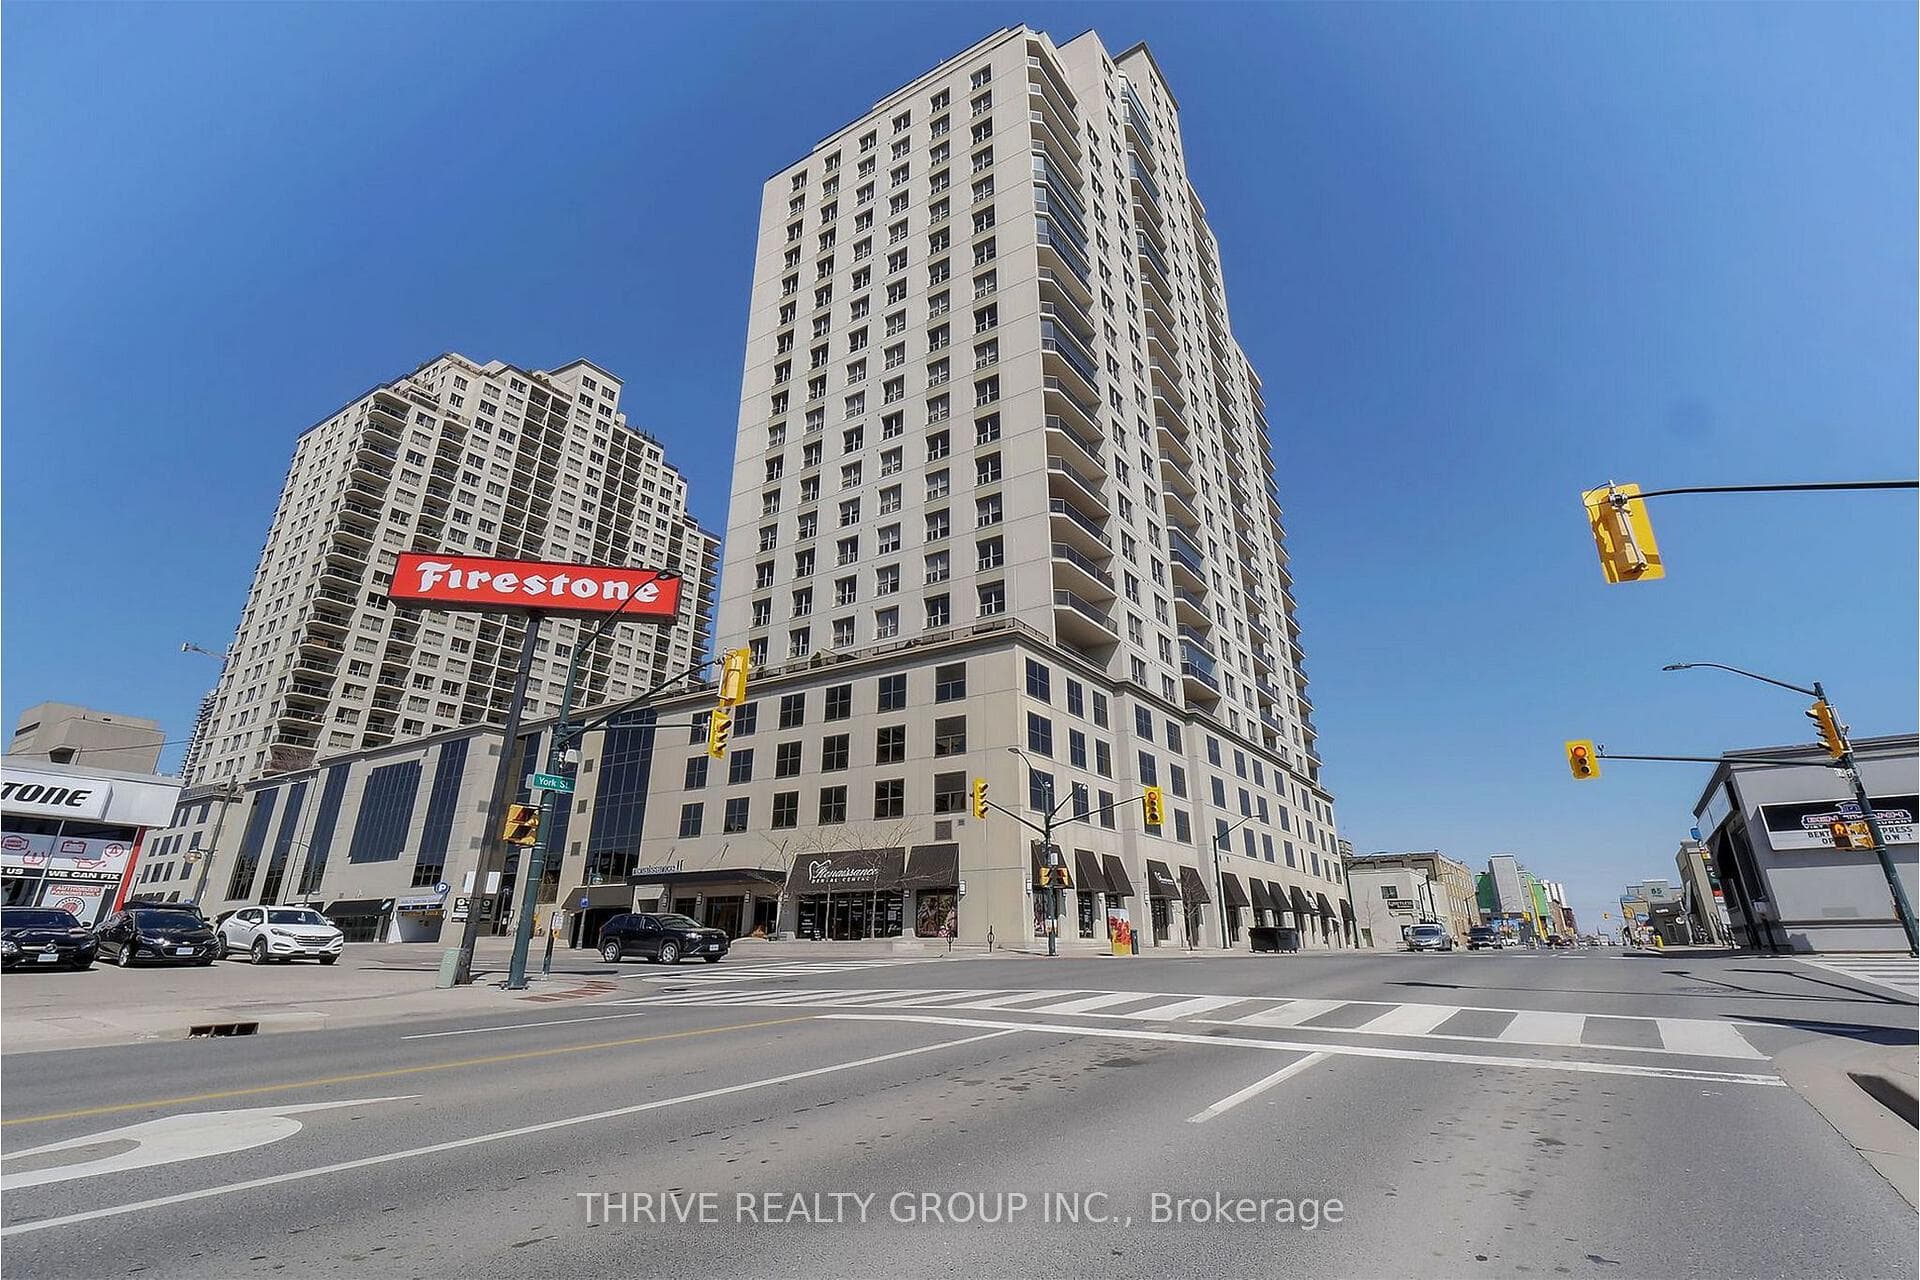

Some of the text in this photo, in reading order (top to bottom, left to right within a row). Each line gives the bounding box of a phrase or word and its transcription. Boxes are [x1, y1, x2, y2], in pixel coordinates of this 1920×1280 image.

[416, 562, 660, 603] Firestone
[539, 776, 568, 789] York St
[1882, 826, 1913, 834] PRESS
[48, 870, 68, 878] WE
[71, 871, 97, 880] CAN
